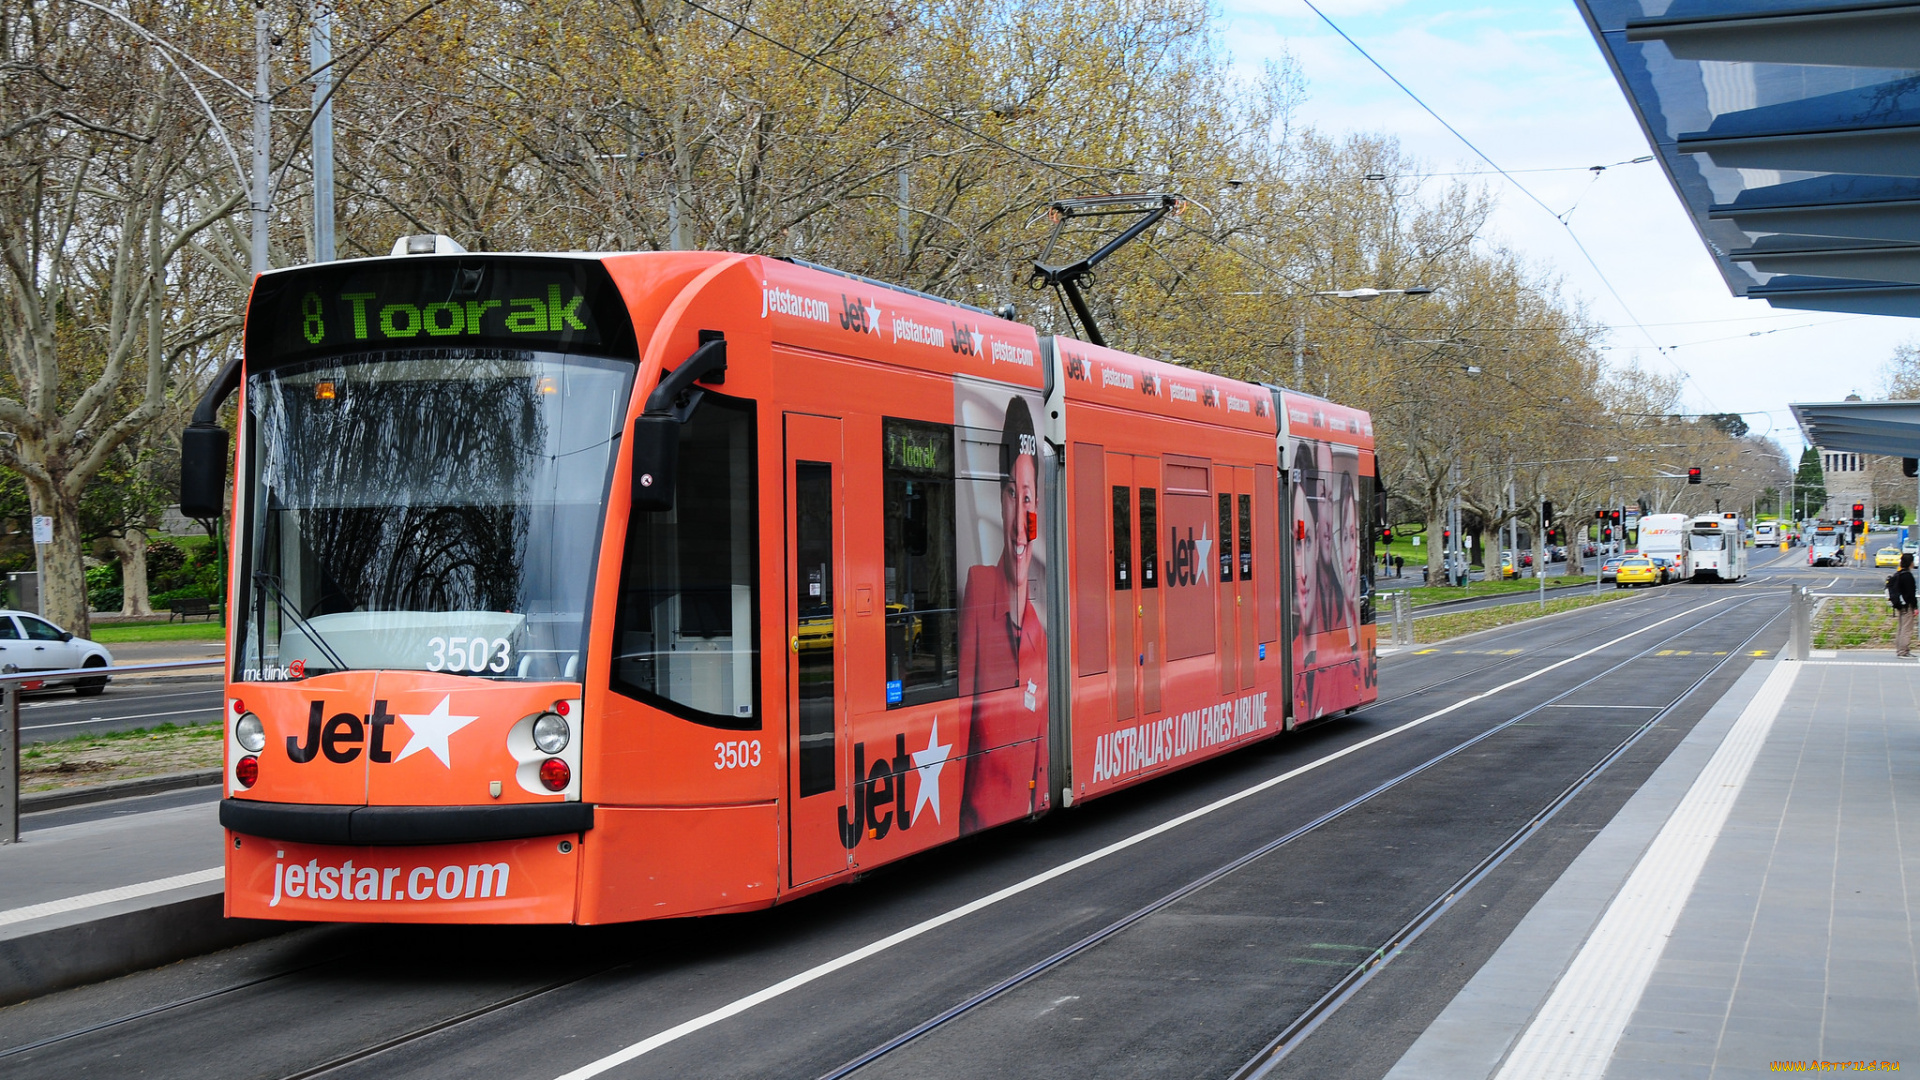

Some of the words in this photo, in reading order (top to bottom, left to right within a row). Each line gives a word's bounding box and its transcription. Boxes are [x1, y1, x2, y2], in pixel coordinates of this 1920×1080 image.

[302, 291, 325, 344] 8
[342, 284, 587, 341] Toorak
[762, 281, 830, 323] jetstar.com
[839, 293, 869, 334] Jet
[892, 311, 945, 348] jetstar.com
[950, 321, 975, 357] Jet
[991, 335, 1034, 367] jetstar.com
[1067, 350, 1085, 382] Jet
[902, 435, 937, 469] Toorak
[1019, 433, 1036, 456] 3503
[1166, 526, 1197, 588] Jet
[243, 664, 289, 681] metlink
[426, 637, 511, 673] 3503
[286, 699, 395, 764] Jet
[1092, 717, 1173, 783] AUSTRALIA'S
[1174, 710, 1201, 757] LOW
[1201, 701, 1232, 748] FARES
[1232, 692, 1268, 738] AIRLINE
[714, 739, 762, 770] 3503
[837, 732, 911, 850] Jet
[269, 850, 510, 907] jetstar.com
